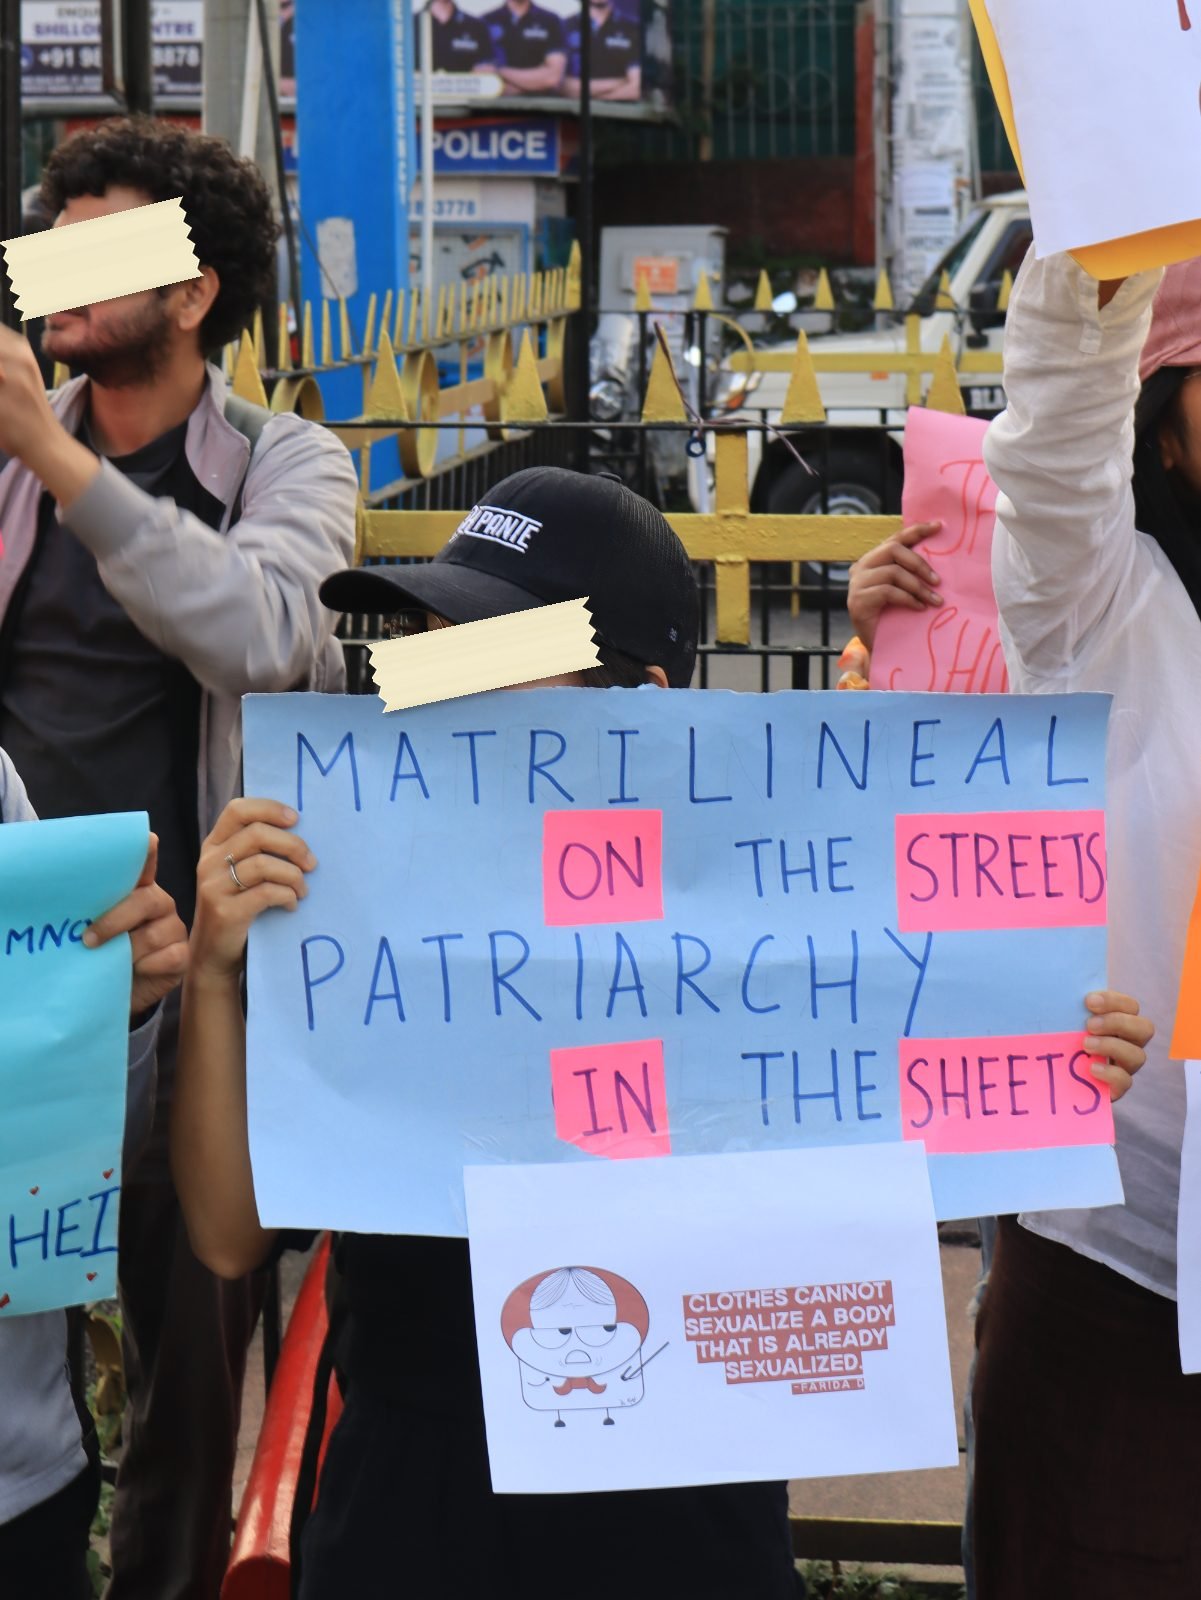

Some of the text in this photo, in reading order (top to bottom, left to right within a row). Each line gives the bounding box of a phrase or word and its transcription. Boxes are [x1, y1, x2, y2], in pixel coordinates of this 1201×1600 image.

[431, 130, 547, 159] POLICE
[296, 714, 1089, 813] MATRILINEAL
[559, 831, 1105, 903] ON THE STREETS
[301, 926, 933, 1037] PATRIARCHY
[572, 1048, 1101, 1137] IN THE SHEETS
[688, 1280, 887, 1313] CLOTHES CANNOT
[685, 1303, 893, 1336] SEXUALIZE A BODY
[697, 1327, 886, 1359] THAT IS ALREADY
[726, 1353, 863, 1380] SEXUALIZED.
